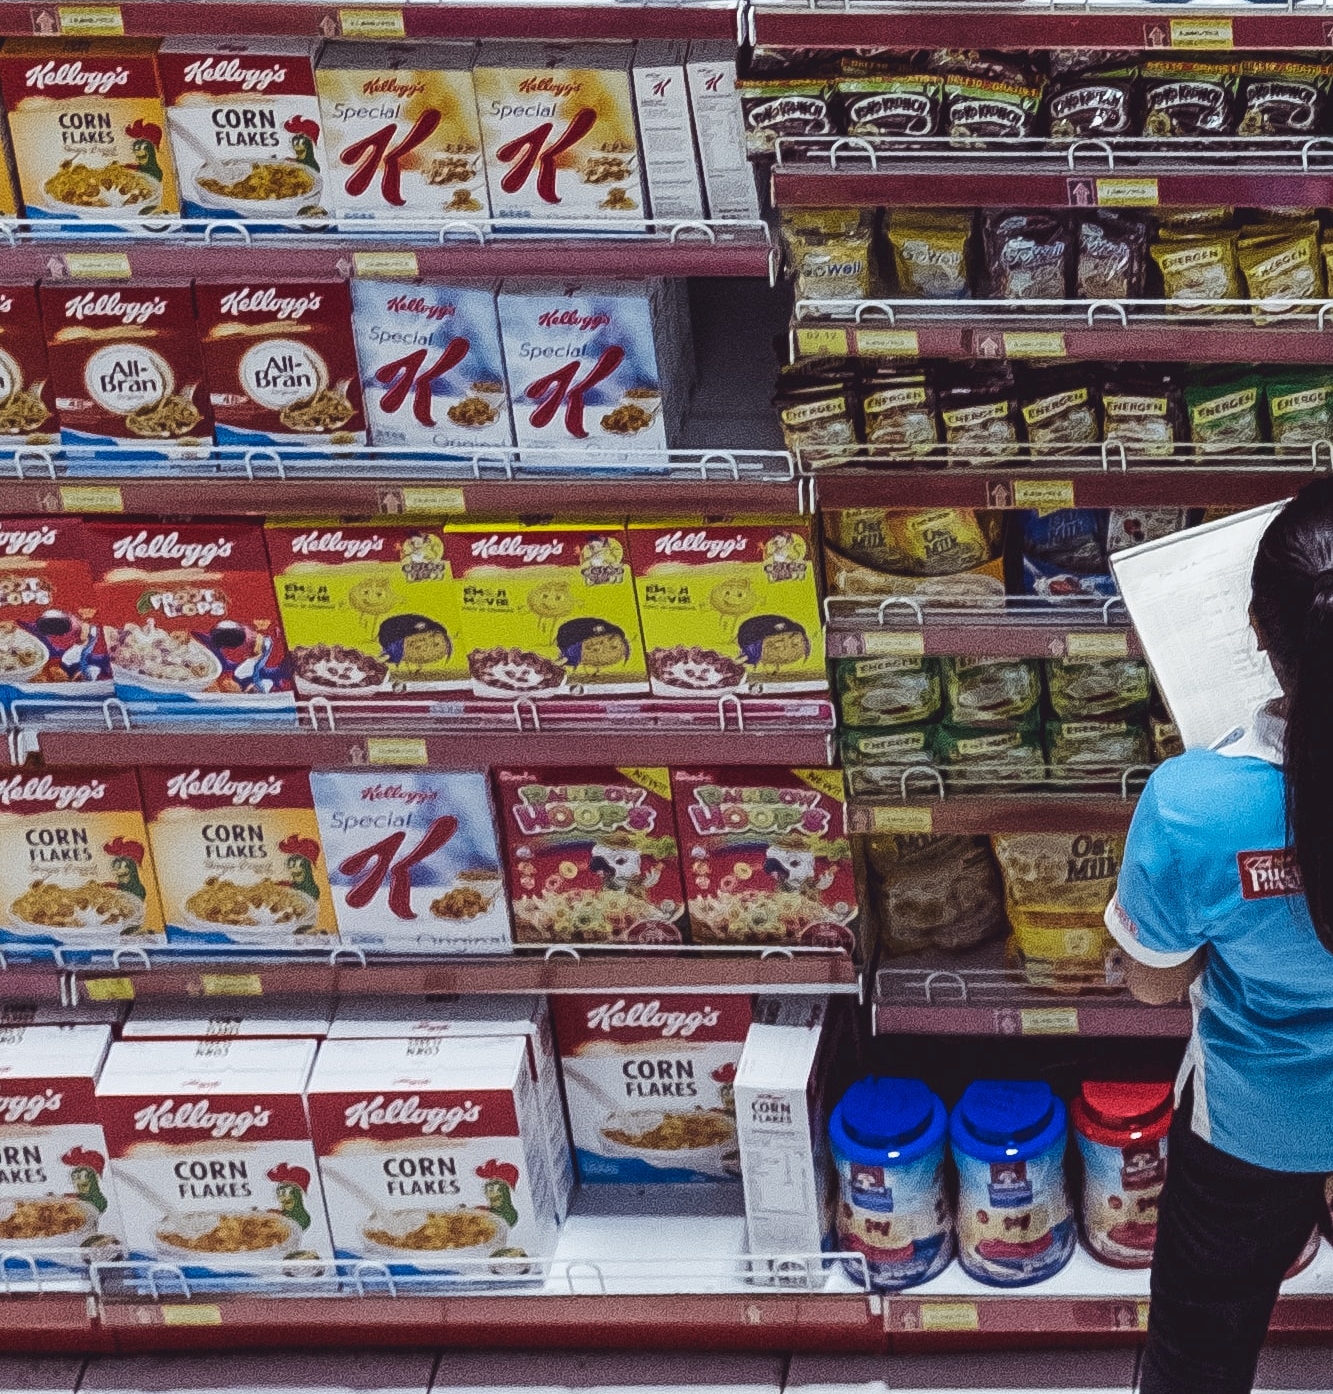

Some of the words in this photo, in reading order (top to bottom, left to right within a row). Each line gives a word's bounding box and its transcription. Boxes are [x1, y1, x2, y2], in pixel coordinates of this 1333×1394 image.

[26, 62, 129, 89] Kellogg's
[183, 59, 287, 89] Kellogg's
[58, 112, 112, 131] CORN
[211, 109, 277, 130] CORN
[333, 102, 400, 121] Special
[490, 102, 557, 121] Special
[62, 130, 115, 146] FLAKES
[216, 130, 280, 148] FLAKES
[340, 109, 441, 207] K
[496, 109, 597, 205] K
[65, 293, 166, 319] Kellogg's
[221, 290, 321, 318] Kellogg's
[369, 327, 435, 346] Special
[520, 343, 588, 361] Special
[100, 374, 159, 396] Bran
[254, 368, 312, 390] Bran
[376, 338, 469, 428] K
[526, 347, 625, 439] K
[113, 534, 233, 568] Kellogg's
[167, 770, 283, 803] Kellogg's
[331, 811, 415, 831] Special
[25, 828, 89, 851] CORN
[202, 824, 264, 845] CORN
[29, 846, 92, 864] FLAKES
[206, 843, 268, 861] FLAKES
[622, 1058, 695, 1080] CORN
[625, 1077, 700, 1097] FLAKES
[174, 1159, 248, 1181] CORN
[383, 1158, 458, 1180] CORN
[179, 1179, 252, 1199] FLAKES
[387, 1177, 461, 1197] FLAKES
